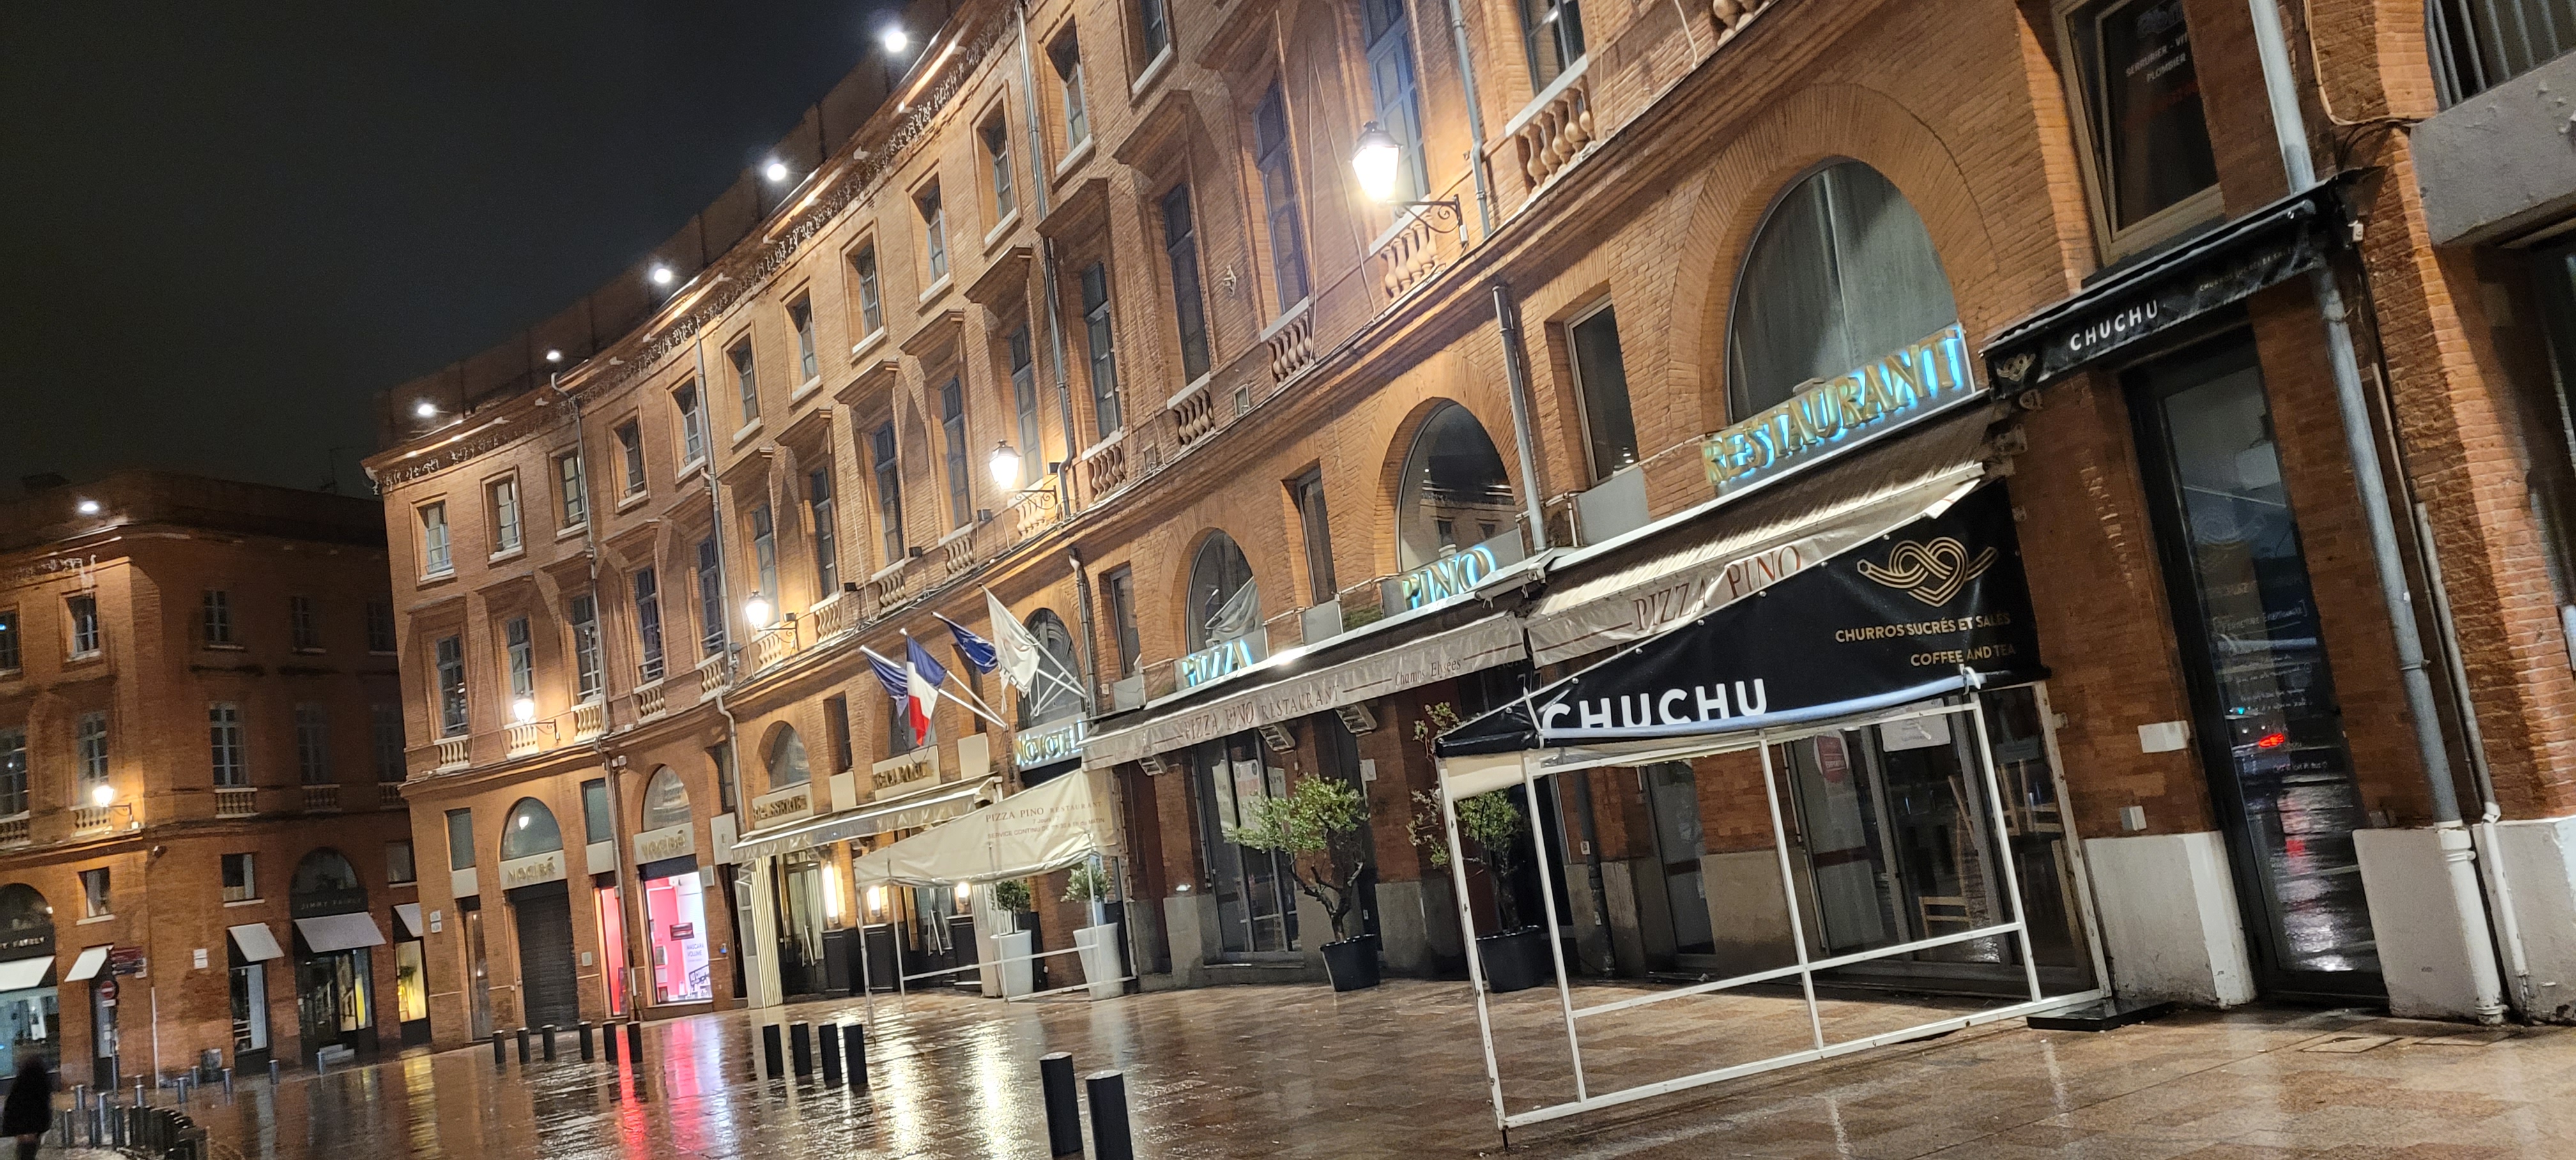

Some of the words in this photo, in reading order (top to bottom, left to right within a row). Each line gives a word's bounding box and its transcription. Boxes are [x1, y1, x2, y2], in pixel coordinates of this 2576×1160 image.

[2070, 299, 2158, 351] CHUCHU
[1700, 327, 1960, 485] RESTAURANT
[1401, 548, 1494, 611] PINO
[1632, 576, 1710, 631] PIZZA
[1726, 545, 1801, 600] PINO
[1835, 624, 1905, 643] CHURROS
[1905, 617, 1955, 636] SUCRÉS
[1958, 616, 1973, 631] ET
[1182, 640, 1251, 688] PIZZA
[1910, 650, 1964, 666] COFFEE
[1966, 646, 1992, 661] AND
[1993, 643, 2016, 657] TEA
[1183, 712, 1219, 740] PIZZA
[1225, 701, 1254, 730] PINO
[1261, 684, 1339, 720] RESTAURANT
[1542, 678, 1767, 729] CHUCHU
[1013, 721, 1083, 765] NOVOTEL
[753, 795, 808, 821] BRASSERIE
[986, 811, 1015, 823] PIZZA
[1020, 807, 1044, 818] PINO
[1050, 801, 1102, 814] RESTAURANT
[988, 831, 1013, 839] SERVICE
[1014, 827, 1041, 836] CONTINU
